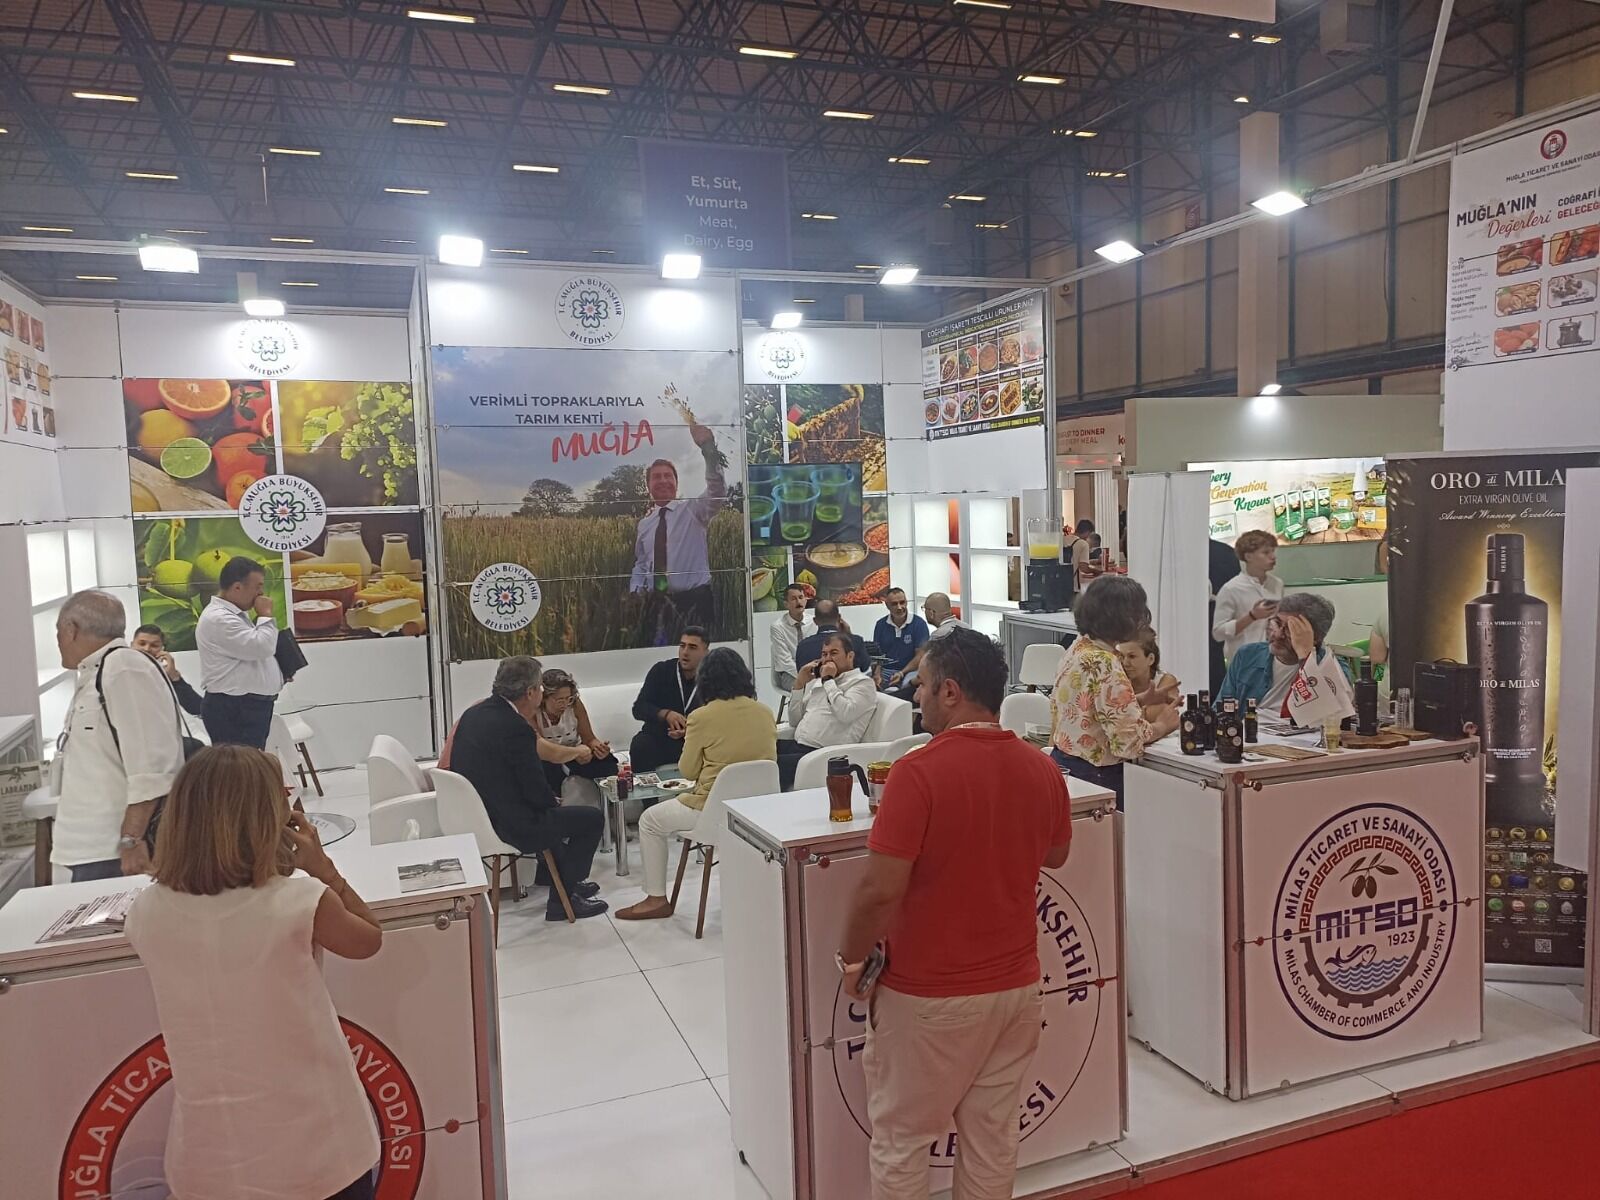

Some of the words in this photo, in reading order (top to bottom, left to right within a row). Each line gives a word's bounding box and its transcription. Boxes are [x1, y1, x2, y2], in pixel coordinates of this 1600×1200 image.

[691, 175, 710, 190] Et,
[713, 177, 741, 192] Süt,
[686, 194, 748, 209] Yumurta
[1557, 188, 1596, 207] COĞRAFİ
[1456, 193, 1537, 227] MUĞLA'NIN
[700, 216, 737, 230] Meat,
[1488, 210, 1552, 239] Değerleri
[684, 234, 723, 250] Dairy,
[728, 236, 753, 251] Egg
[470, 394, 528, 407] VERİMLİ
[531, 396, 645, 407] TOPRAKLARIYLA
[516, 414, 559, 424] TARIM
[564, 412, 604, 424] KENTİ
[552, 419, 654, 463] MUĞLA
[1210, 471, 1232, 486] very
[1430, 472, 1480, 490] ORO
[1486, 475, 1496, 484] di
[1504, 468, 1566, 487] MILA
[280, 478, 323, 516] BÜYÜKŞEHİR
[1210, 480, 1270, 500] Generation
[1460, 495, 1482, 505] EXTRA
[1484, 494, 1510, 504] VIRGIN
[1512, 492, 1534, 503] OLIVE
[1536, 492, 1548, 503] OIL
[1234, 495, 1272, 512] Knows
[1438, 510, 1478, 520] Award
[1478, 509, 1516, 521] Winning
[258, 534, 312, 550] BELEDİYESİ
[484, 616, 529, 630] BELEDİYESİ
[1508, 678, 1540, 688] MILAS
[1284, 867, 1310, 920] MİLAS
[1306, 819, 1358, 865] TİCARET
[1362, 816, 1379, 830] VE
[1382, 817, 1429, 847] SANAYİ
[1423, 848, 1446, 894] ODASI
[1388, 930, 1416, 946] 1923
[1297, 984, 1336, 1024] CHAMBER
[1337, 1016, 1350, 1027] OF
[1352, 999, 1407, 1028] COMMERCE
[1407, 982, 1424, 1002] AND
[1422, 920, 1447, 981] INDUSTRY
[100, 1045, 172, 1116] TİCA
[346, 1036, 392, 1082] AYİ
[378, 1081, 412, 1170] ODASI
